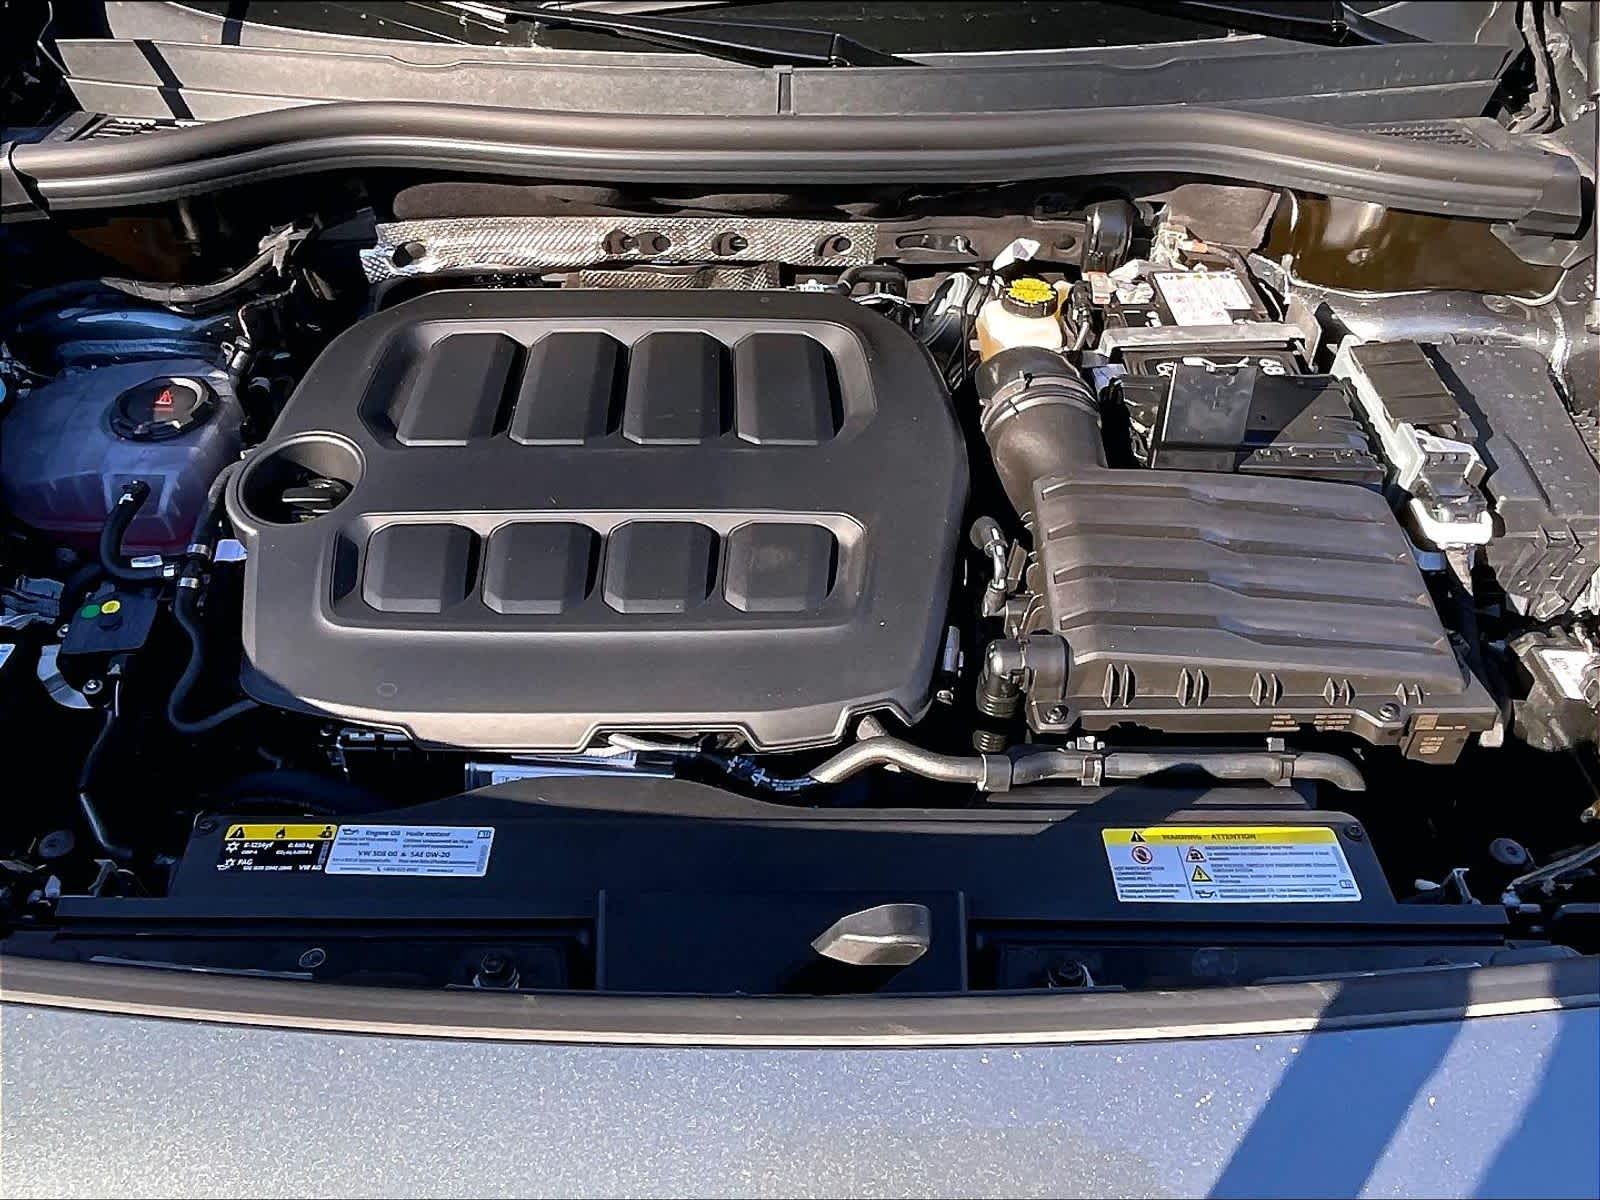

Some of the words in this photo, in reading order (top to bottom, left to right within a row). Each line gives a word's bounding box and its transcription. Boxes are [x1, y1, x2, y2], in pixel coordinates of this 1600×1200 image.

[1211, 833, 1256, 841] ATTENTION
[410, 850, 424, 858] SAE
[425, 850, 450, 858] 0W-20
